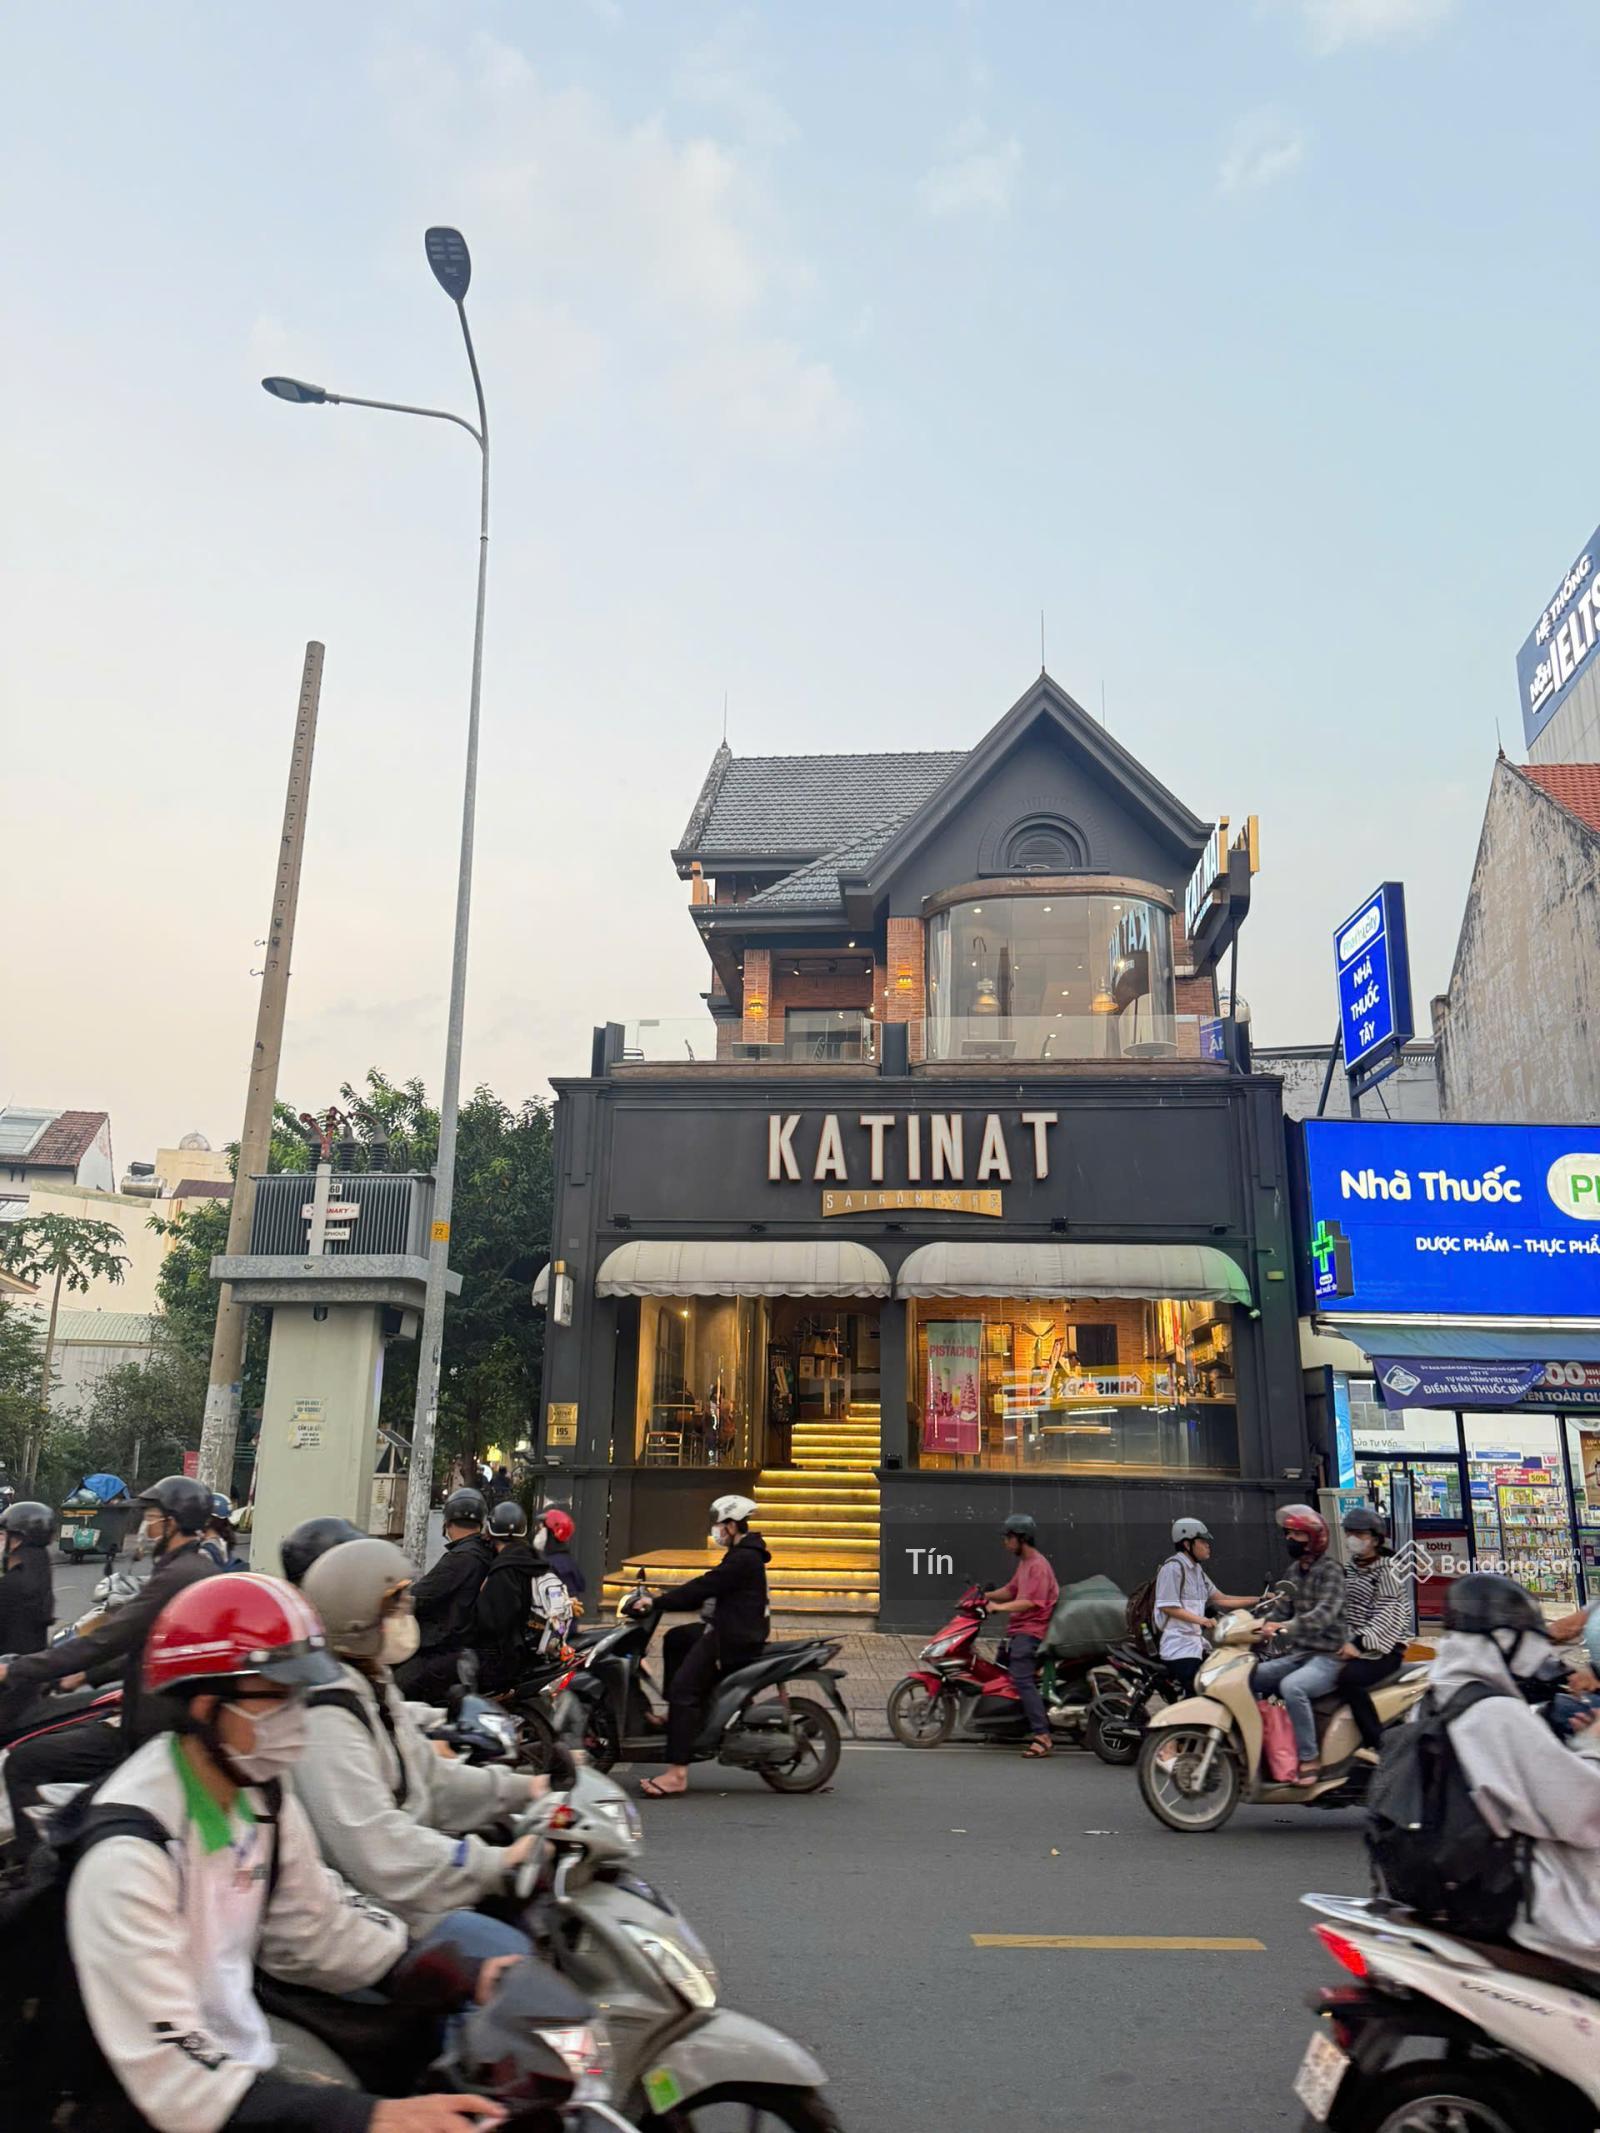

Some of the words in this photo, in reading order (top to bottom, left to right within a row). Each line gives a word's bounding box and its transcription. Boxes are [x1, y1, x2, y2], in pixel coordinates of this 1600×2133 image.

[1536, 612, 1554, 646] HỆ
[1550, 554, 1593, 621] THỐNG
[1353, 955, 1373, 988] NHÀ
[1350, 979, 1380, 1021] THUỐC
[1359, 1020, 1375, 1047] TÂY
[768, 1112, 1058, 1181] KATINAT
[1341, 1168, 1411, 1200] Nhà
[1418, 1165, 1522, 1202] Thuốc
[1416, 1236, 1460, 1255] DƯỢC
[1464, 1231, 1509, 1252] PHẨM
[1524, 1239, 1566, 1257] THỰC
[1423, 1382, 1451, 1394] ĐIỂM
[1450, 1382, 1473, 1393] BÁN
[1472, 1383, 1509, 1394] THUỐC
[1545, 1389, 1581, 1402] TOÀN
